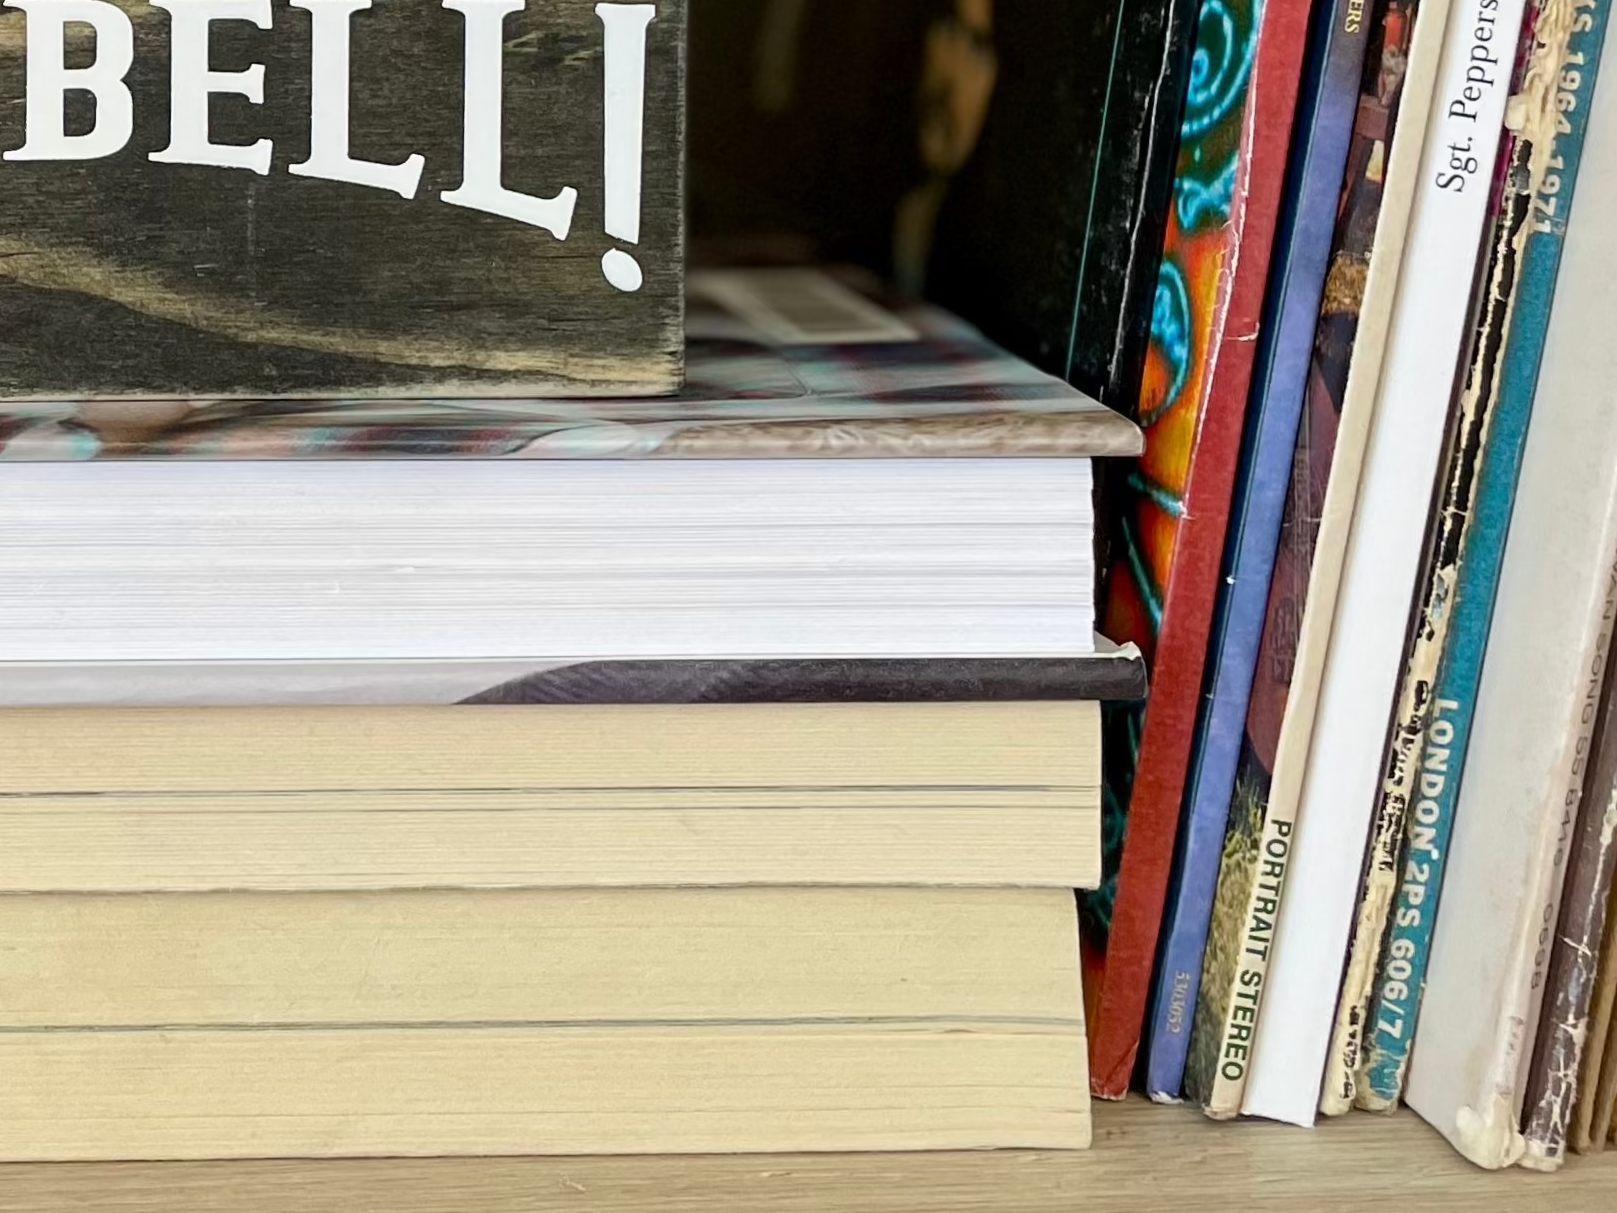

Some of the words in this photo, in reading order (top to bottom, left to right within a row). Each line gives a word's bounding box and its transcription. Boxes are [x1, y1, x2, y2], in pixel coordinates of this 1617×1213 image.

[1434, 136, 1476, 195] Sgt.
[1581, 632, 1609, 725] SONG
[1412, 699, 1458, 846] LONDON
[1244, 817, 1293, 963] PORTRAIT
[1394, 859, 1431, 927] 2PS
[1219, 968, 1263, 1083] STEREO
[1376, 938, 1416, 1040] 606/7
